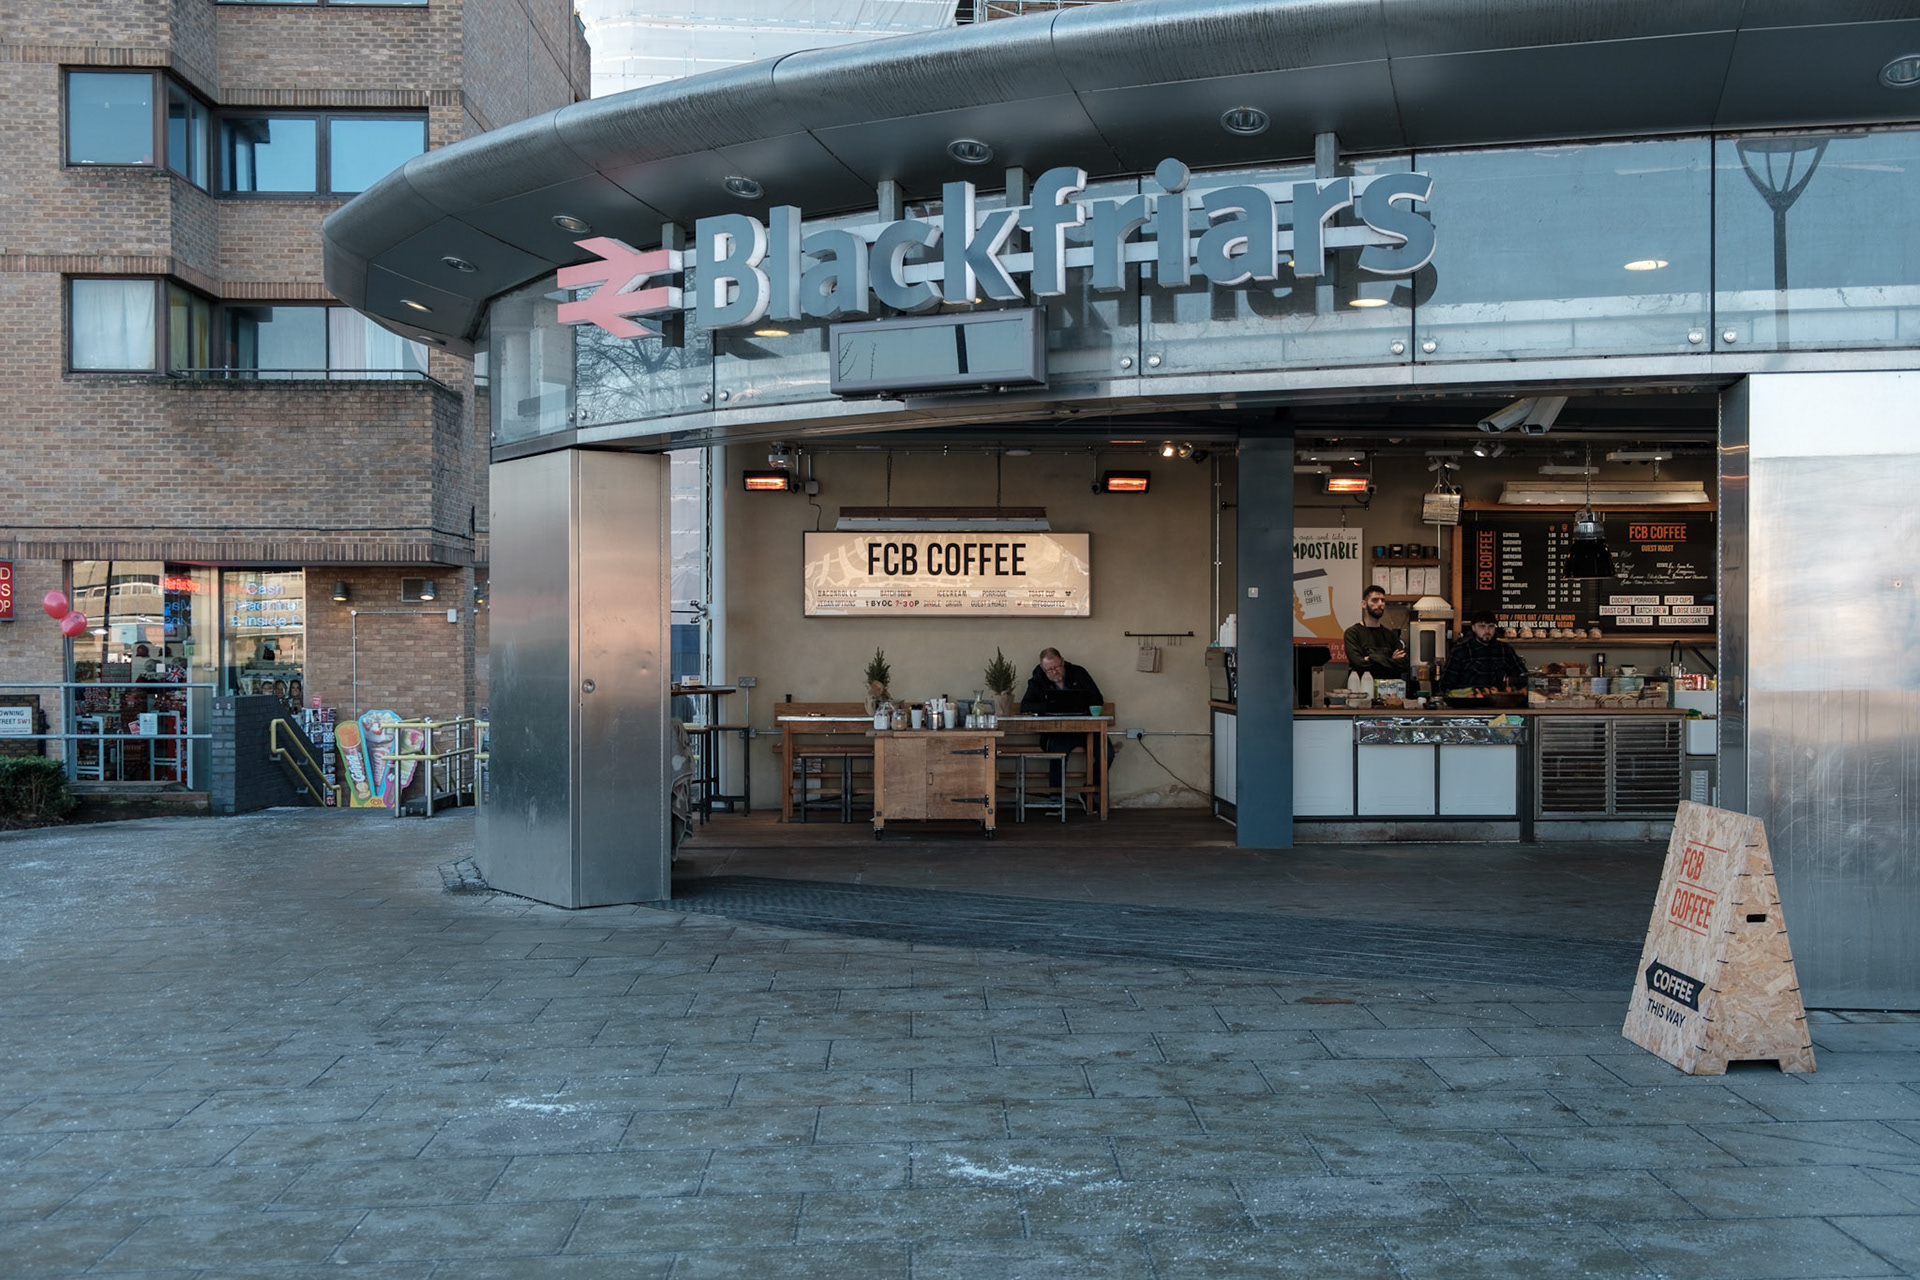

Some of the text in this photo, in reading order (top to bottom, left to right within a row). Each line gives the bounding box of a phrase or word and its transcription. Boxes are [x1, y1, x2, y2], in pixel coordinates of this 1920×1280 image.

[695, 157, 1436, 330] Blackfriars
[1629, 526, 1687, 539] FCB COFFEE
[868, 542, 1026, 576] FCB COFFEE
[1479, 530, 1493, 590] FCB COFFEE
[246, 582, 285, 595] Cash
[245, 615, 287, 627] inside
[1680, 847, 1705, 881] FCB
[1670, 887, 1714, 930] COFFEE
[1653, 968, 1695, 1003] COFFEE
[1647, 998, 1686, 1028] THIS WAY
